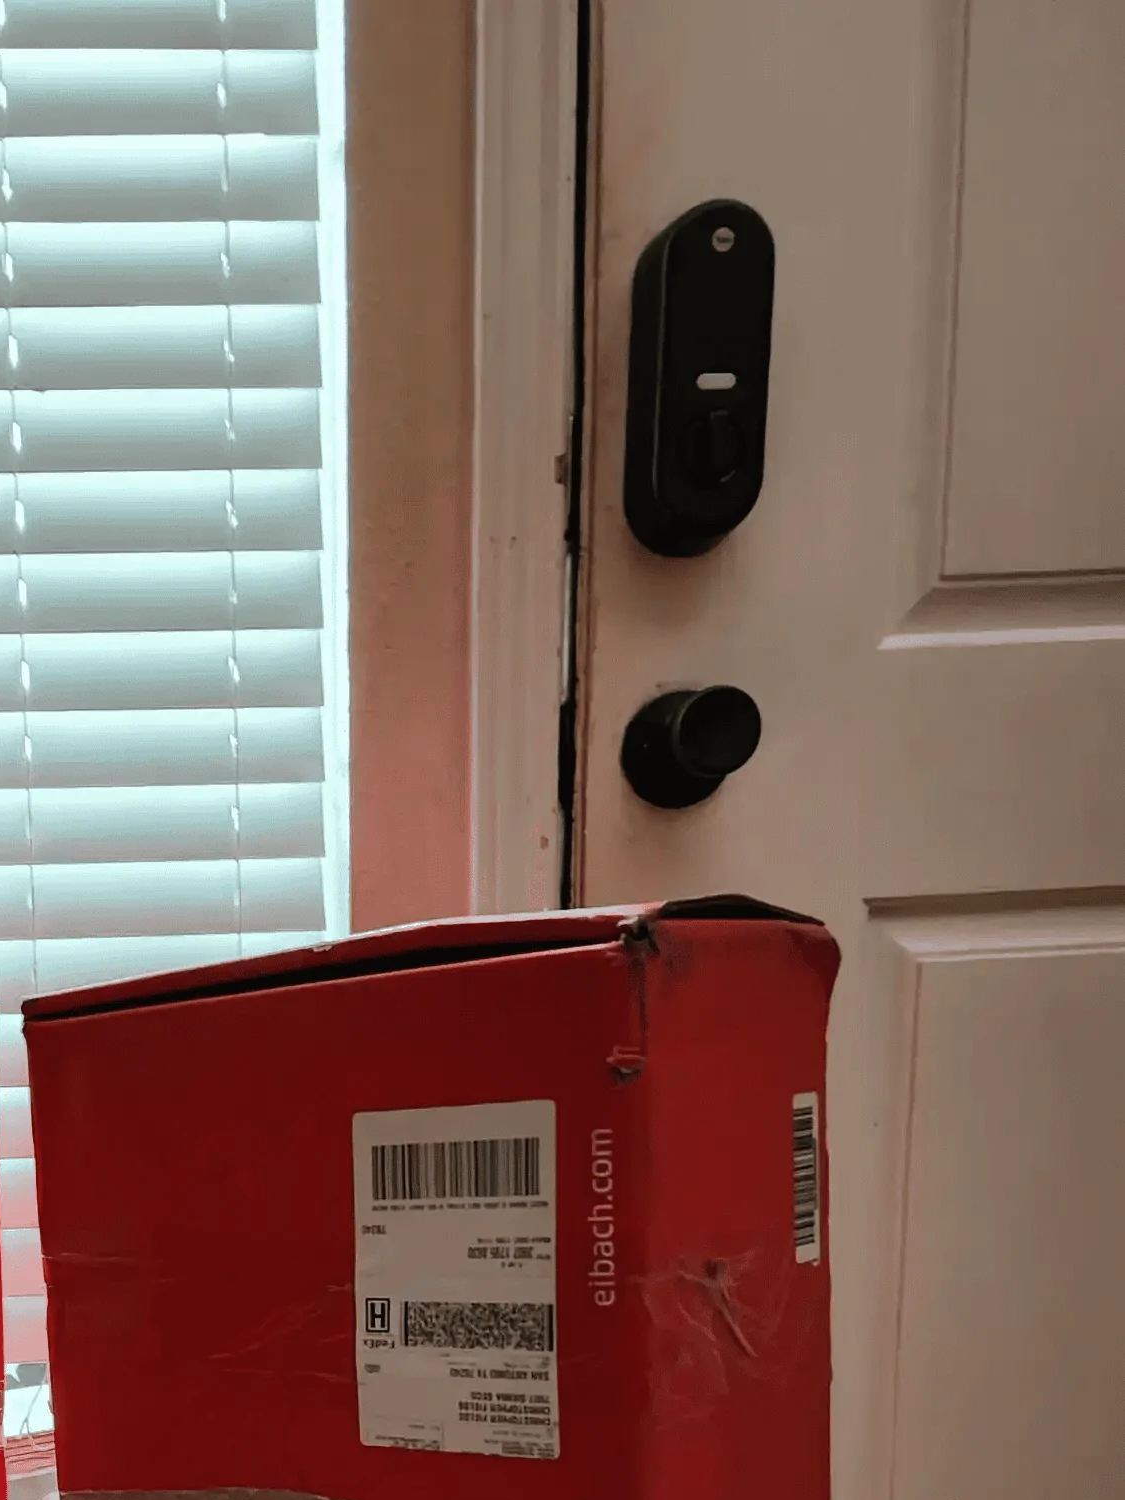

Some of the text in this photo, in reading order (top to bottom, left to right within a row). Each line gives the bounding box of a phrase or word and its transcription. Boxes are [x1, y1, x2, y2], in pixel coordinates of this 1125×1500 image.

[587, 1128, 617, 1307] eibach.com
[370, 1302, 386, 1329] H
[364, 1339, 395, 1349] FedEx
